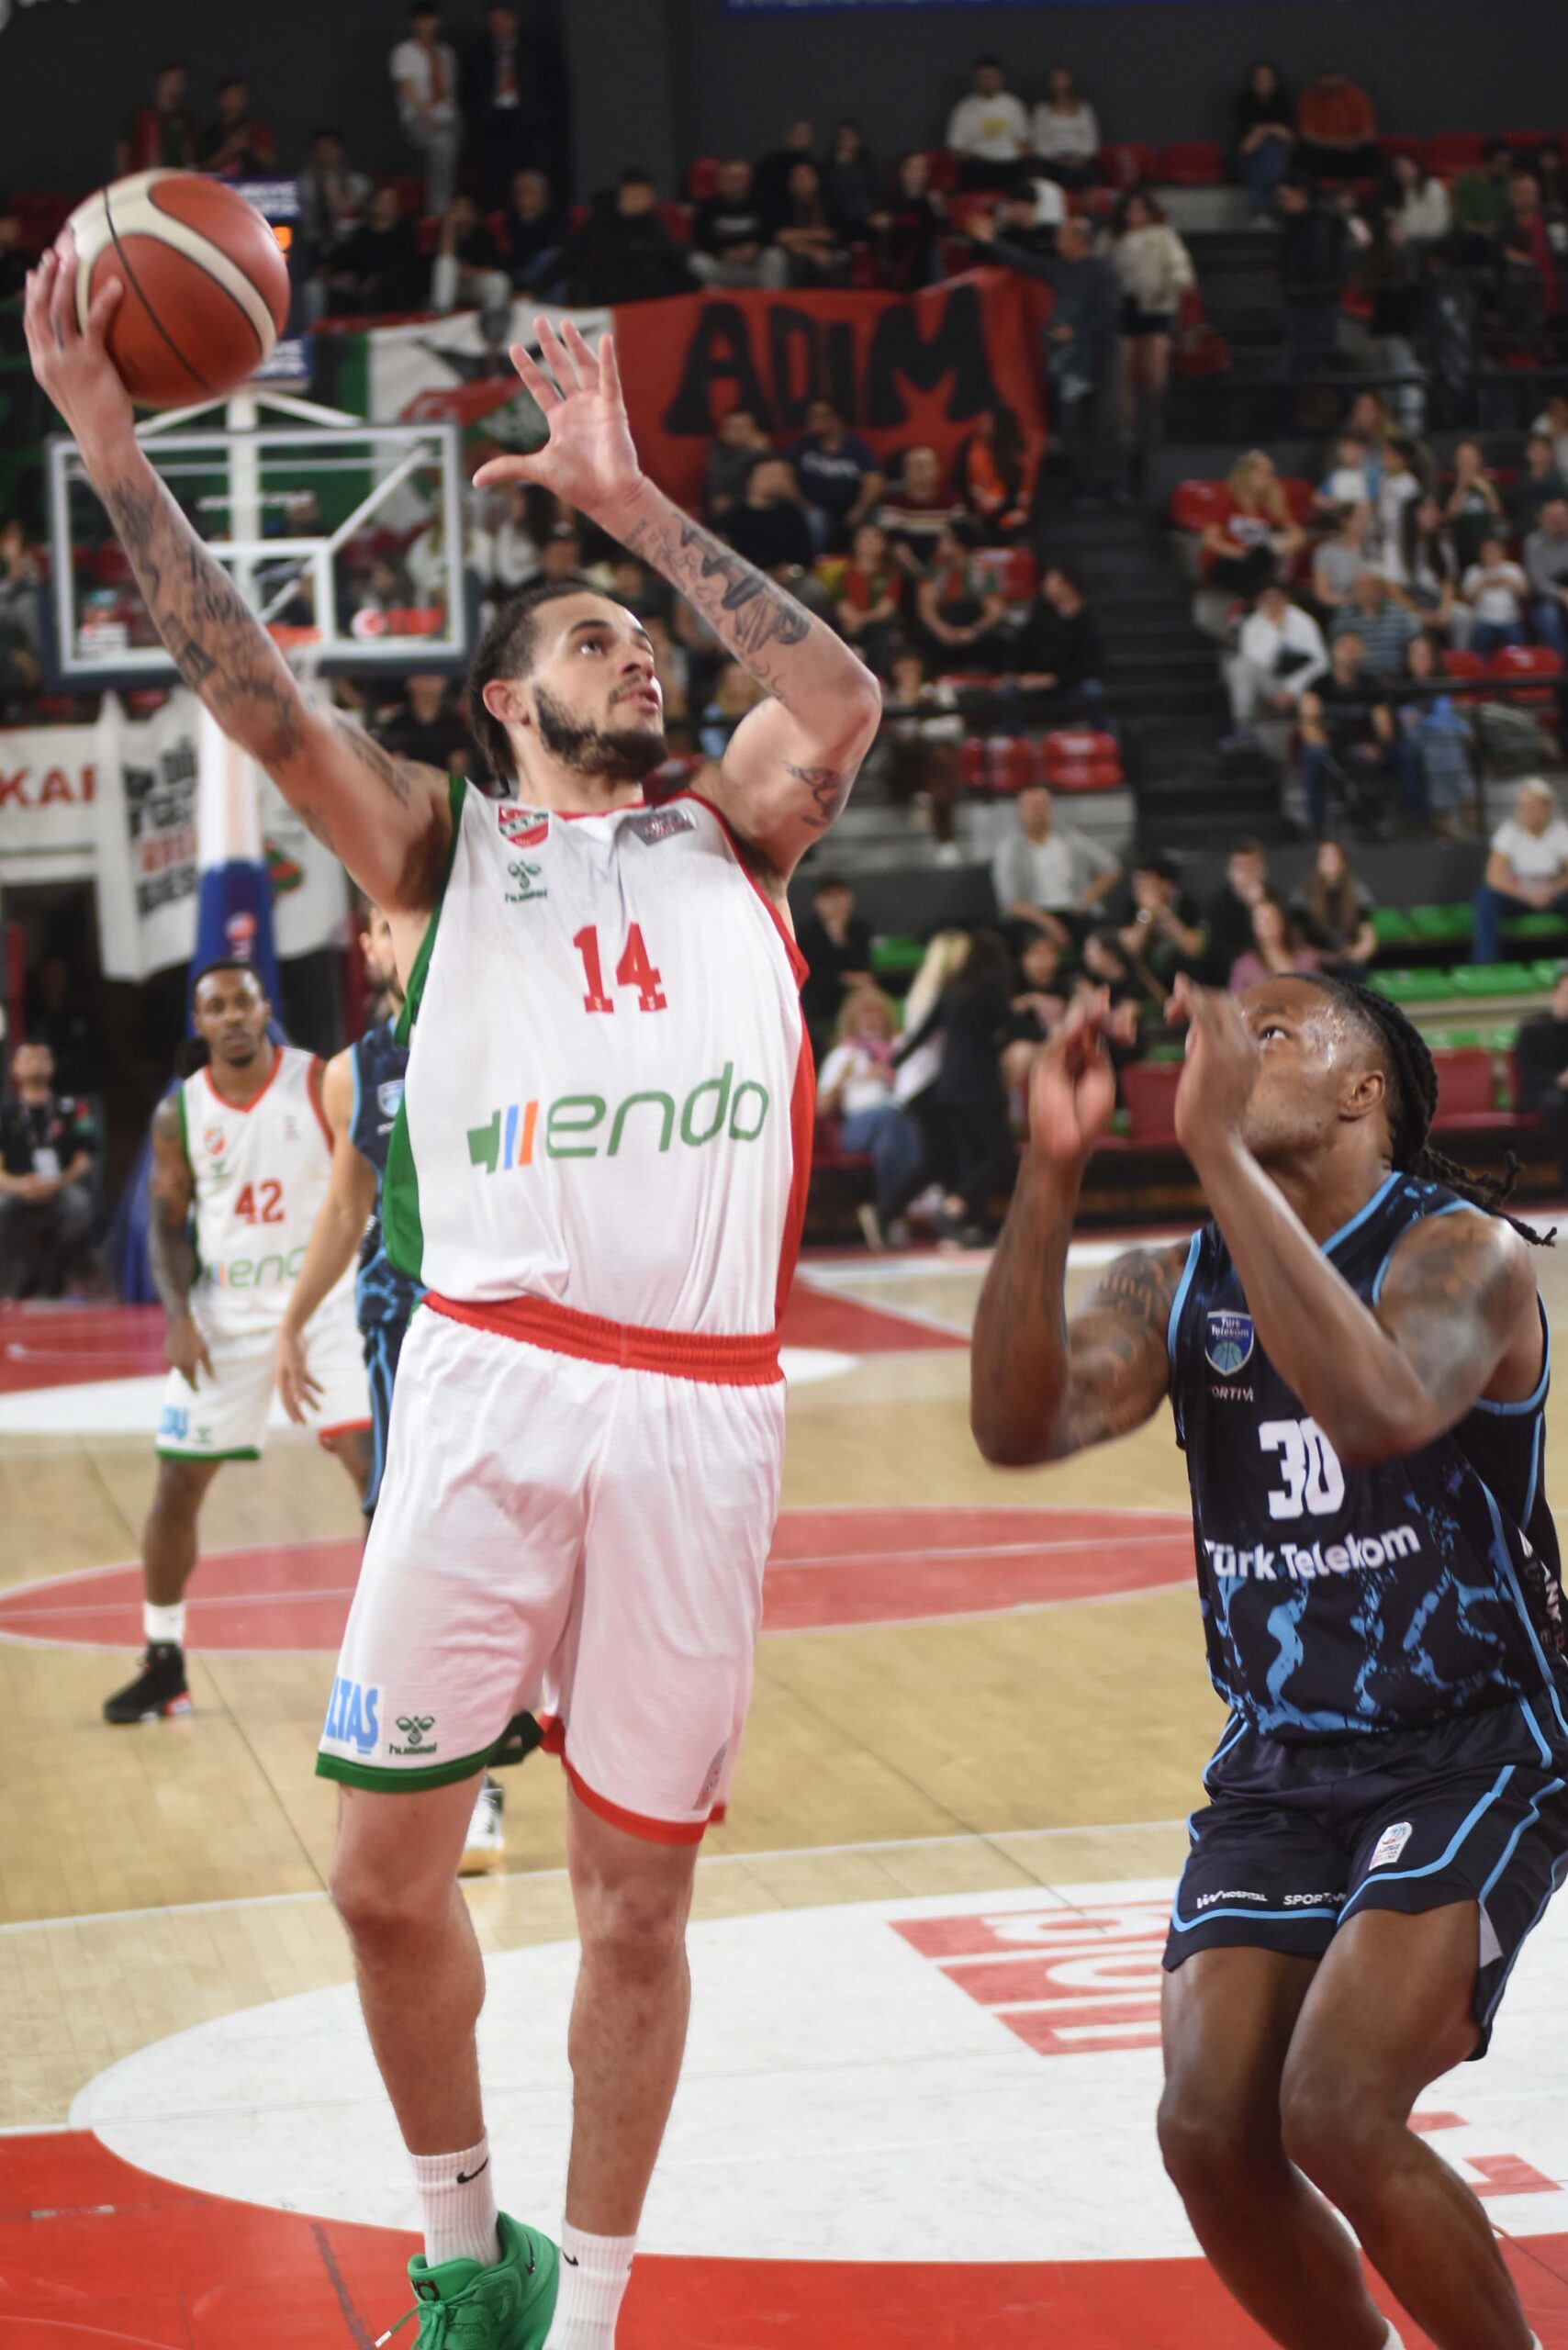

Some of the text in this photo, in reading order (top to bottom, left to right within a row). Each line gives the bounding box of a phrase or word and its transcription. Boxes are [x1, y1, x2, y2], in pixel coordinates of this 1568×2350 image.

[663, 284, 998, 435] ADIM
[573, 921, 668, 1013] 14
[545, 1061, 769, 1158] endo
[234, 1179, 286, 1225] 42
[1259, 1417, 1345, 1520] 30
[1204, 1525, 1421, 1581] Türk Telekom
[388, 1742, 438, 1755] hummel
